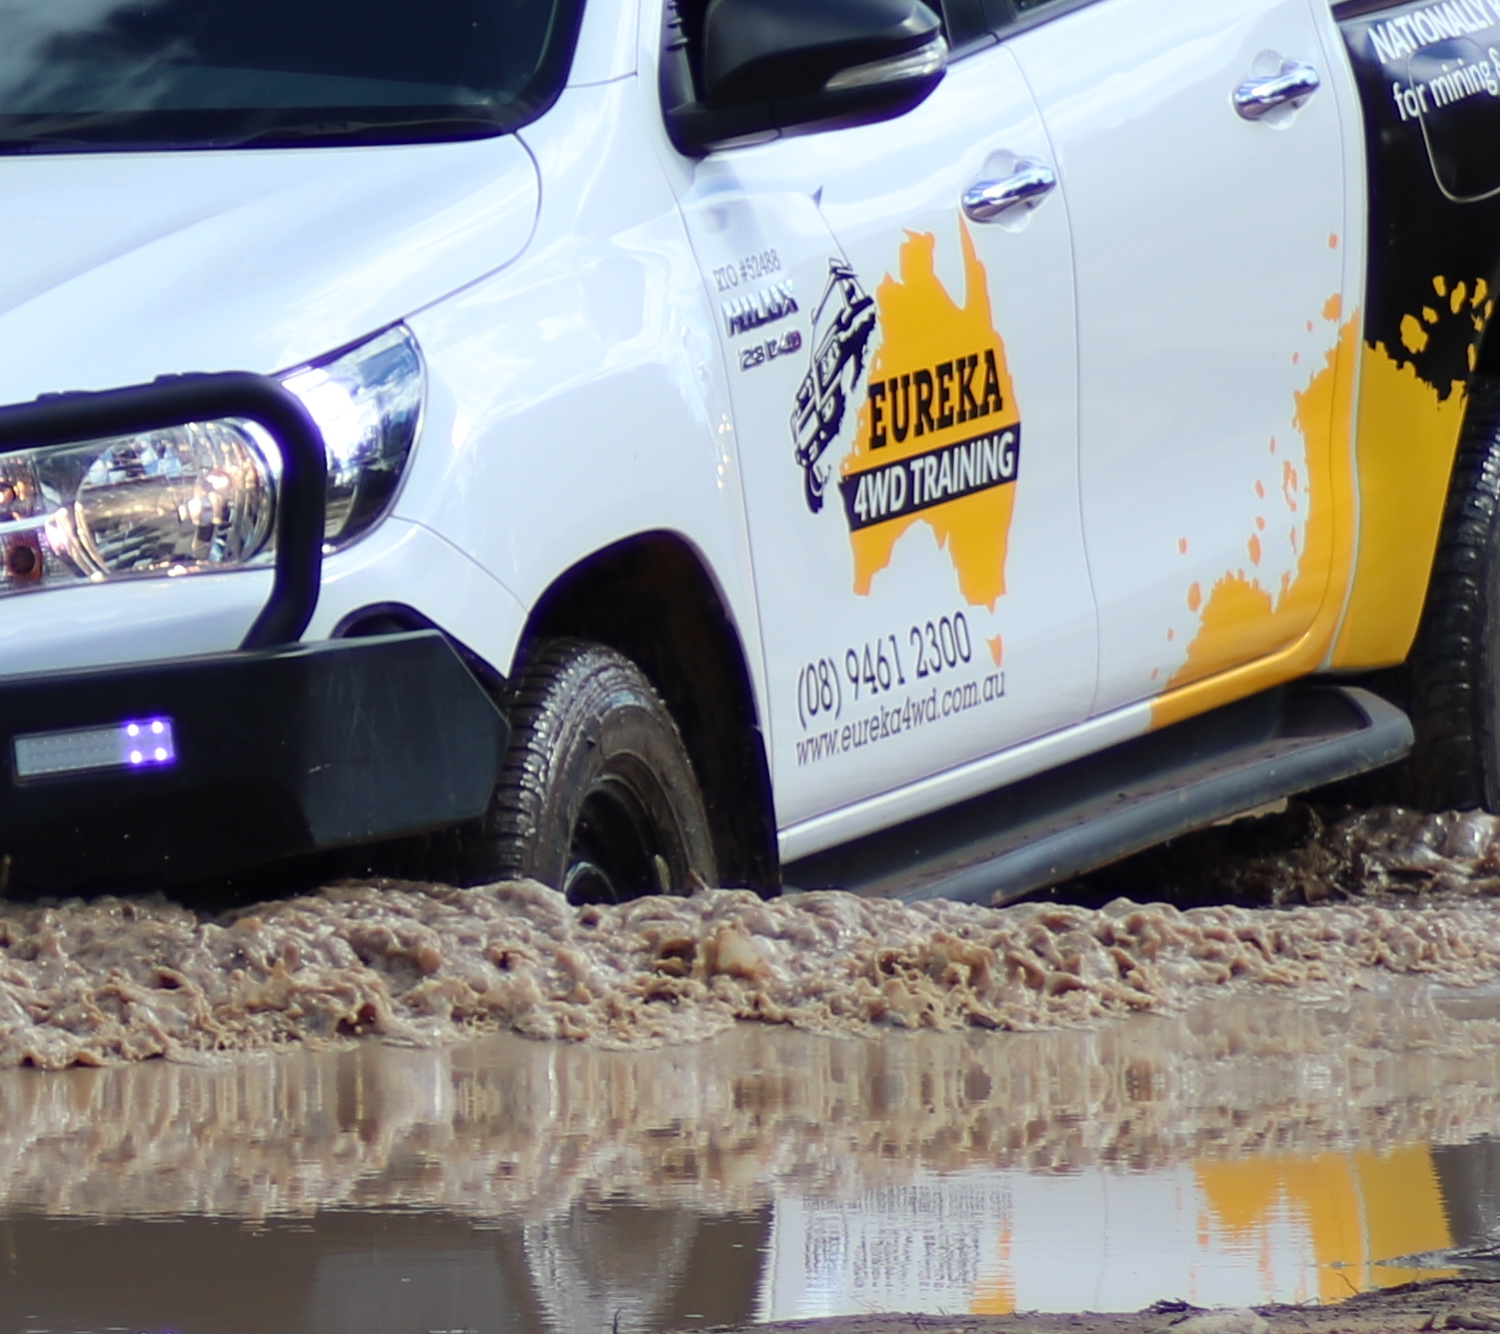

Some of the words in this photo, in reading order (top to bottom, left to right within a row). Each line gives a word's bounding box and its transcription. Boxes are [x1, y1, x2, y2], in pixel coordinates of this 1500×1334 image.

[1393, 82, 1429, 121] for
[1428, 58, 1499, 108] mining
[713, 264, 738, 292] RTO
[720, 279, 799, 338] HILUX
[868, 348, 1003, 451] EUREKA
[854, 465, 907, 521] 4WD
[910, 432, 1014, 505] TRAINING
[798, 656, 841, 731] (08)
[845, 634, 905, 701] 9461
[910, 610, 972, 679] 2300
[796, 671, 1005, 767] www.eureka4wd.com.au
